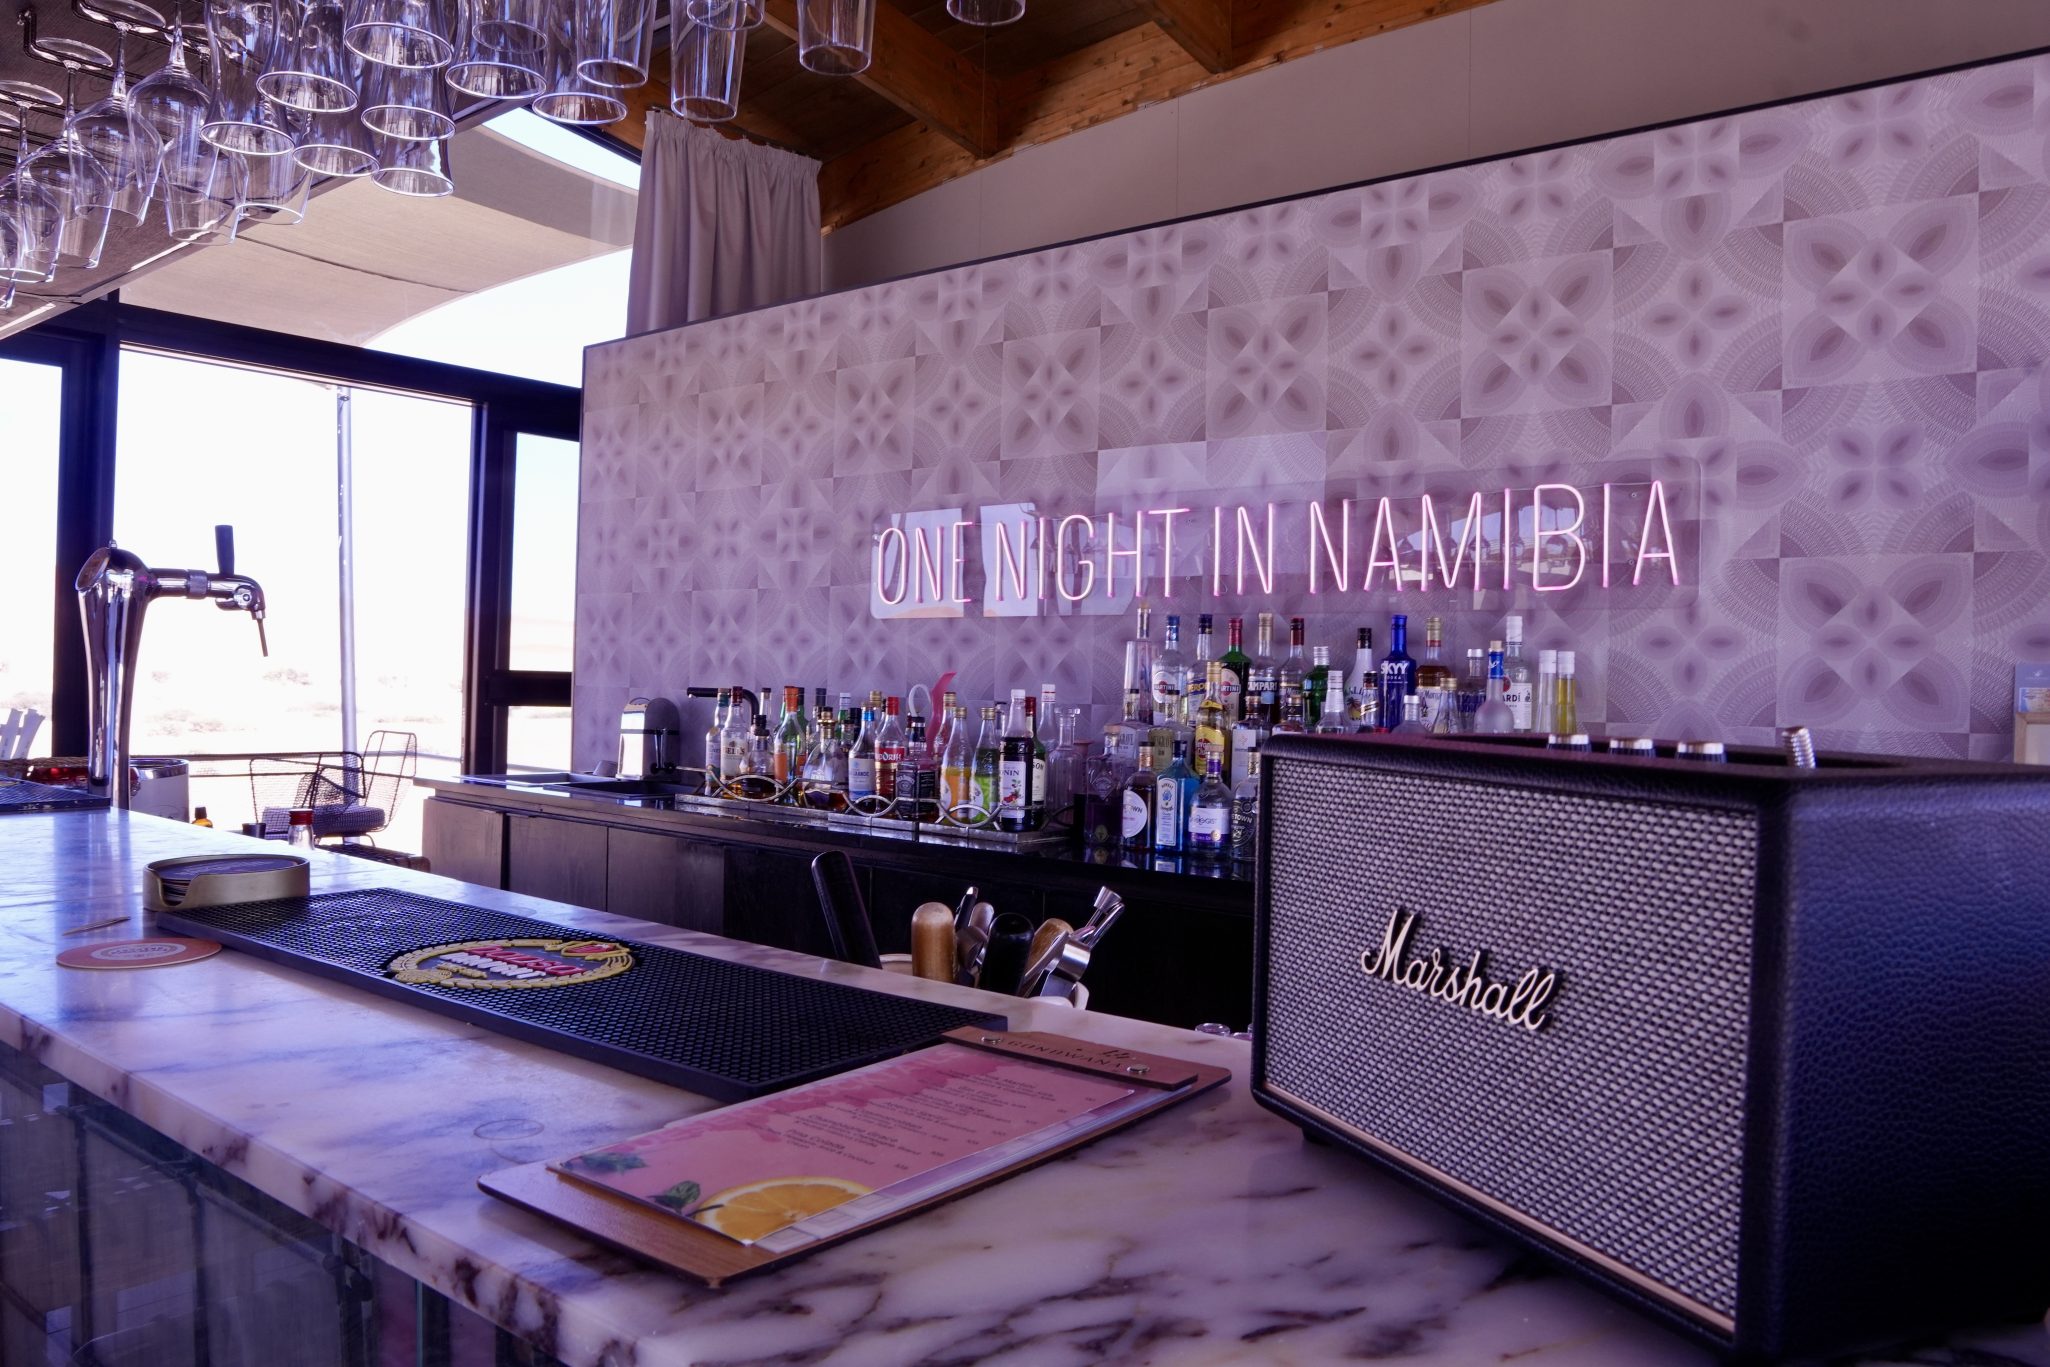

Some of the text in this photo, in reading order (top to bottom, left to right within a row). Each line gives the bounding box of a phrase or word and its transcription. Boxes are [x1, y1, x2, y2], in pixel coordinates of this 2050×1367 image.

[877, 479, 1680, 606] ONE NIGHT IN NAMIBIA
[1221, 684, 1240, 693] ARTINI
[1380, 661, 1409, 675] SKYY
[1361, 909, 1556, 1031] Marshall
